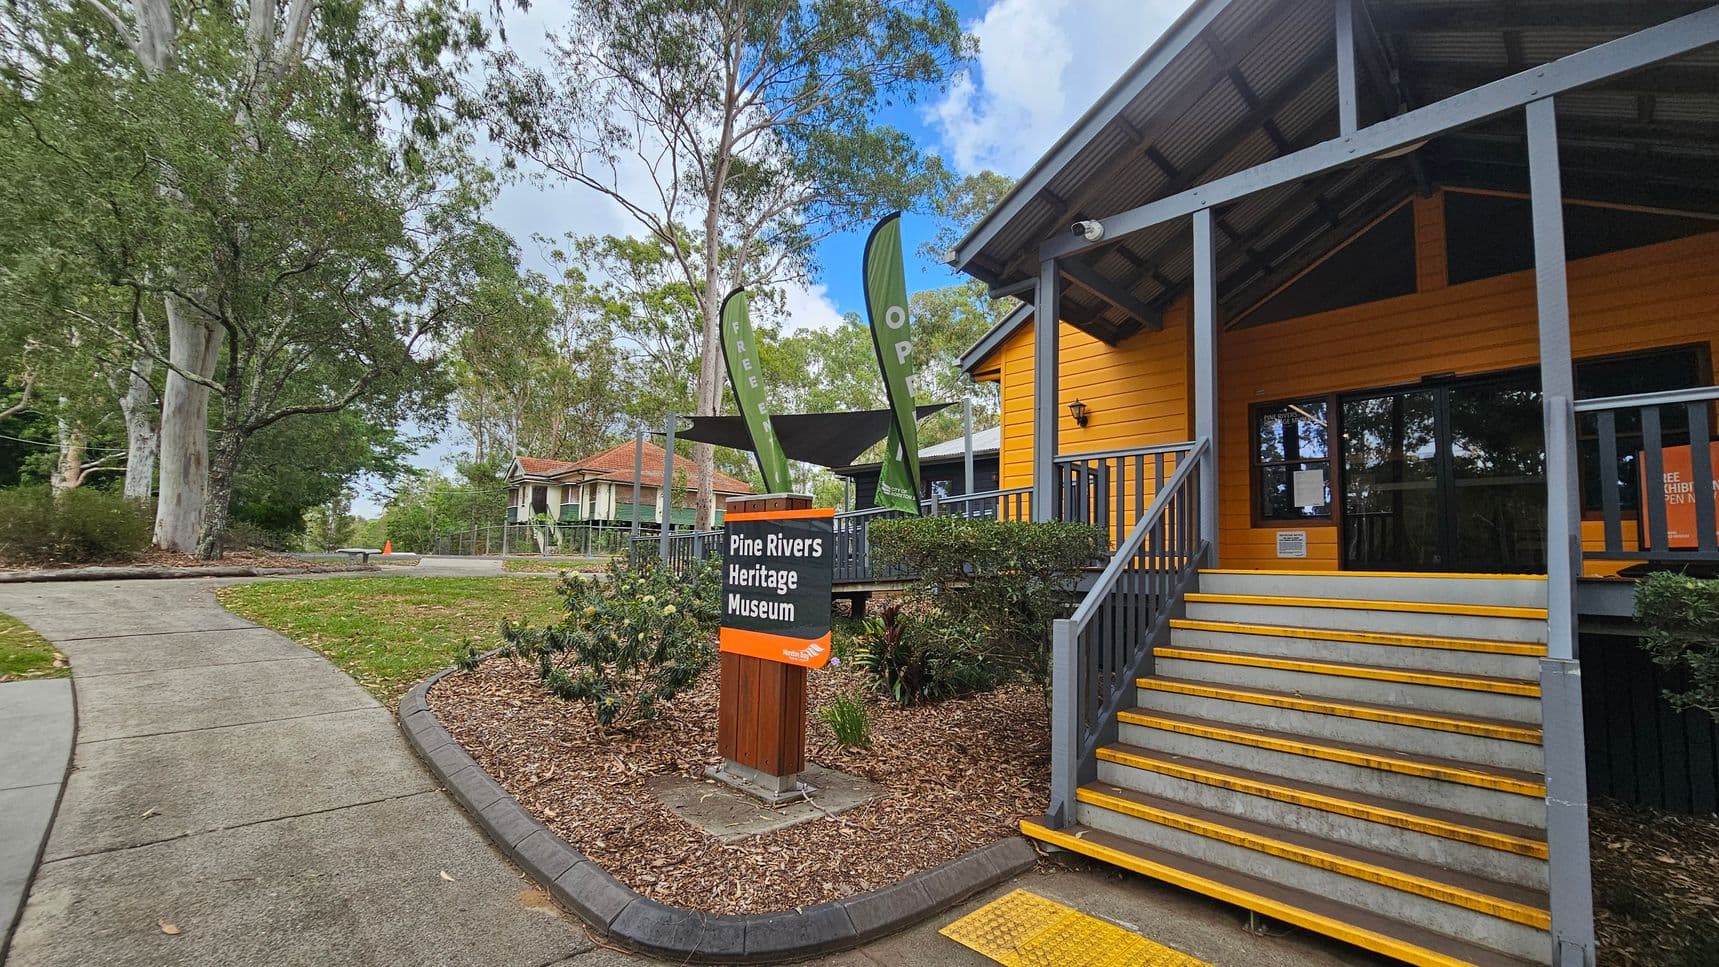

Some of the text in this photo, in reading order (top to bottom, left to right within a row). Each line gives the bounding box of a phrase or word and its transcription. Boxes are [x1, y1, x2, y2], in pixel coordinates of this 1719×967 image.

[732, 321, 758, 388] FREE
[885, 305, 919, 432] OPE
[730, 533, 823, 557] Pine Rivers
[729, 564, 798, 594] Heritage
[728, 593, 795, 621] Museum
